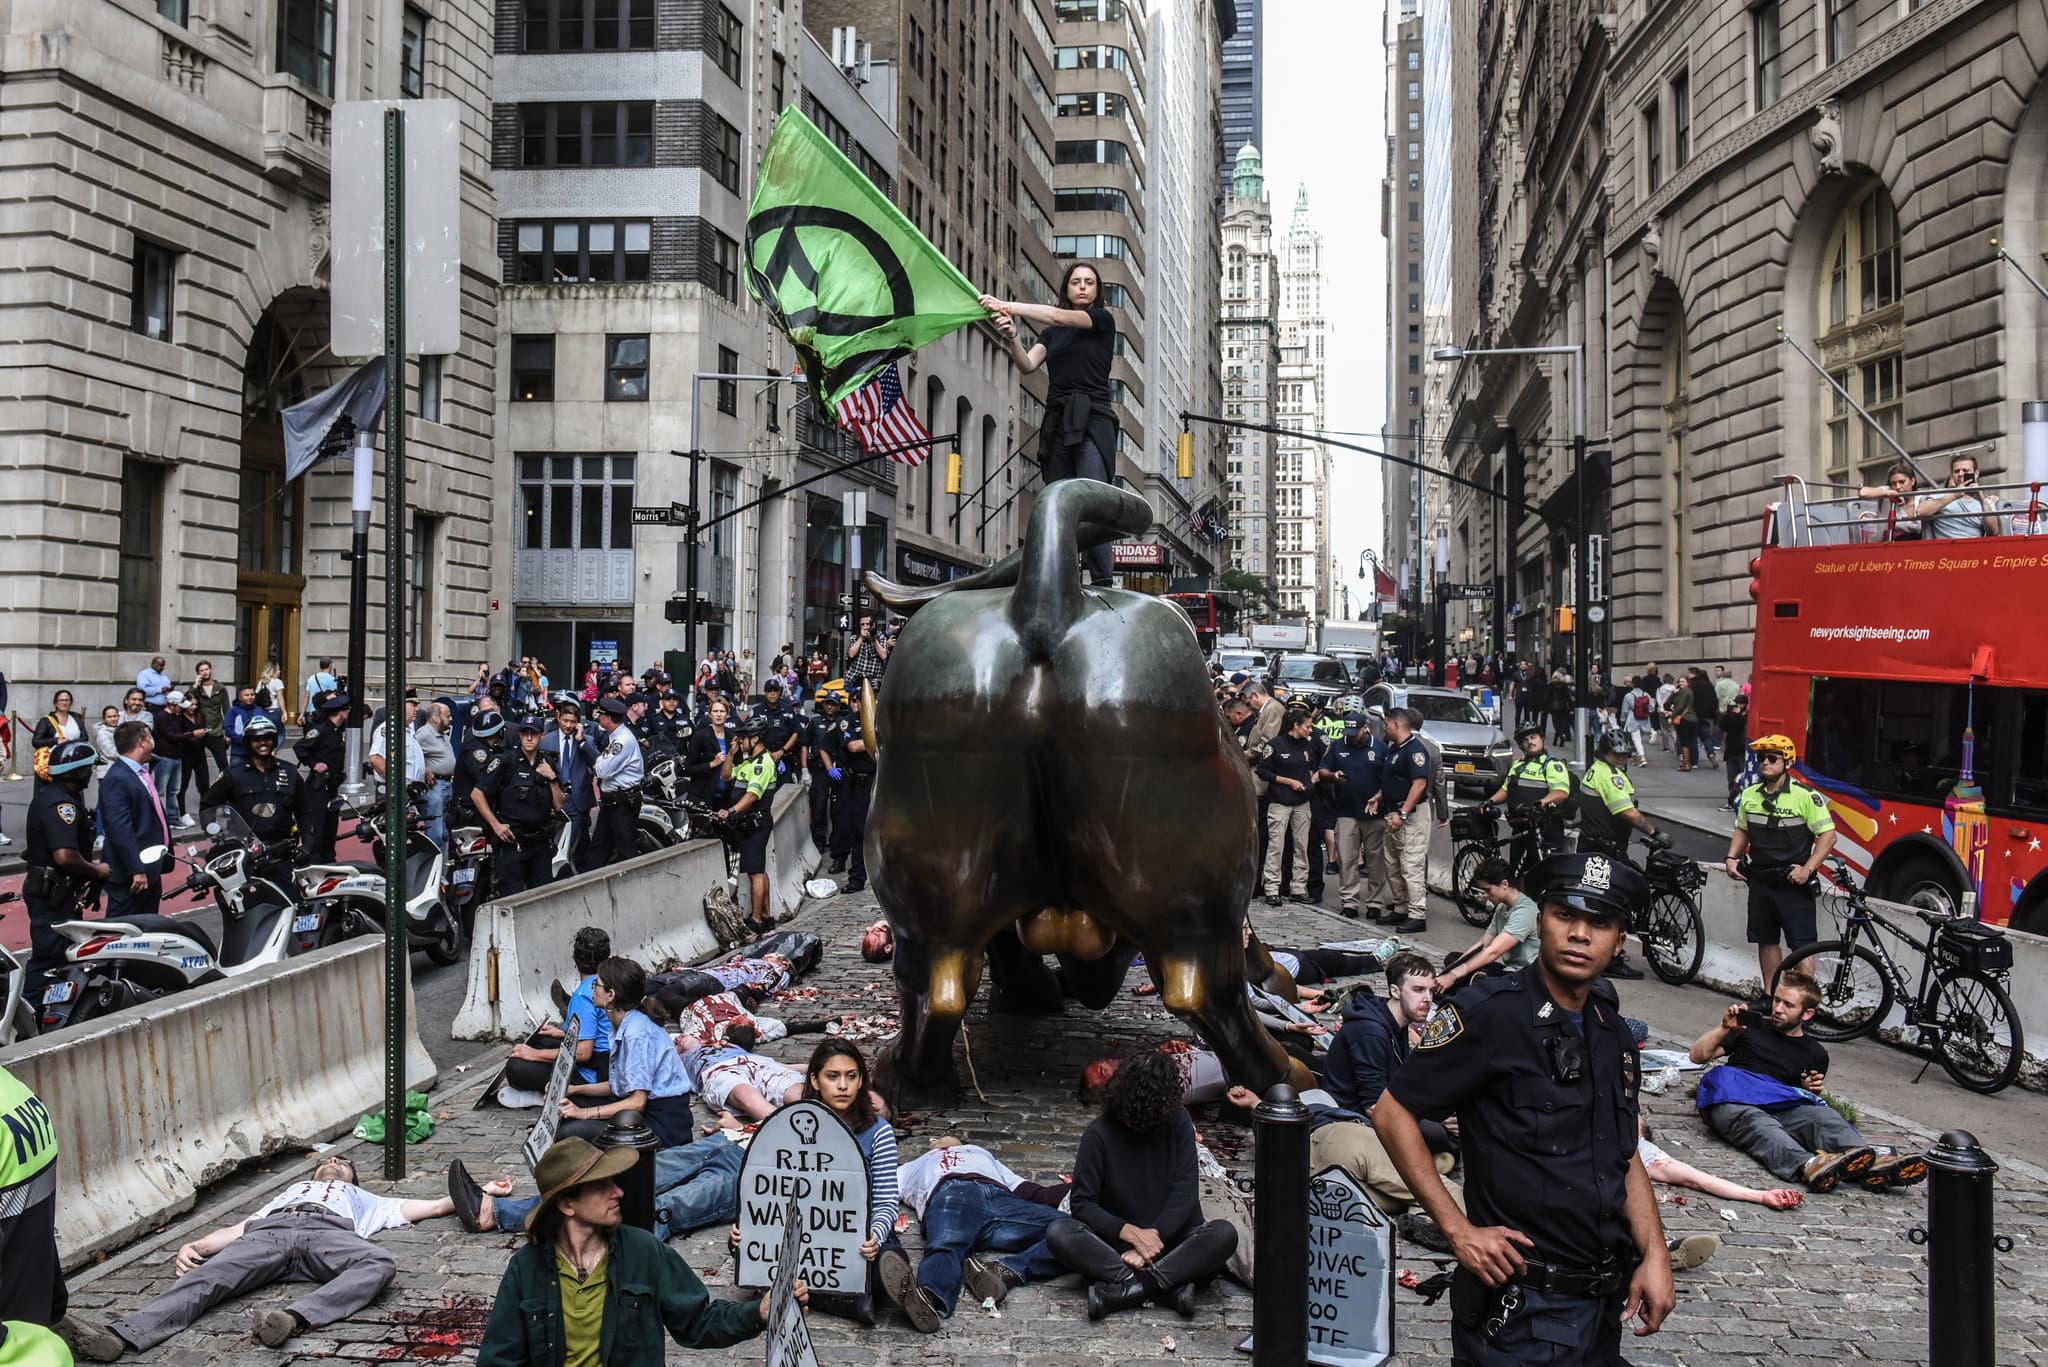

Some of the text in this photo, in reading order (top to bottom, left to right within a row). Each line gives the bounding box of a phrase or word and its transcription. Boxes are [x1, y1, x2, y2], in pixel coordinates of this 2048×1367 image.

[634, 511, 659, 521] Morris
[1814, 562, 1846, 574] Statue
[1848, 560, 1858, 573] of
[1860, 559, 1895, 575] Liberty
[1903, 558, 1935, 571] Times
[1938, 557, 1979, 572] Square
[1993, 554, 2037, 570] Empire
[1464, 588, 1486, 596] Morris
[1810, 625, 1930, 642] newyorksightseeing.com
[1776, 807, 1793, 816] OLICE
[181, 955, 205, 968] NYPD
[1, 1096, 56, 1166] NYP
[776, 1149, 834, 1172] R.I.P.
[755, 1174, 844, 1202] DIED IN
[810, 1206, 857, 1233] DUE
[747, 1241, 847, 1269] CLIATE
[768, 1266, 840, 1288] CAOS
[1309, 1276, 1349, 1299] AME
[1309, 1301, 1338, 1321] OO
